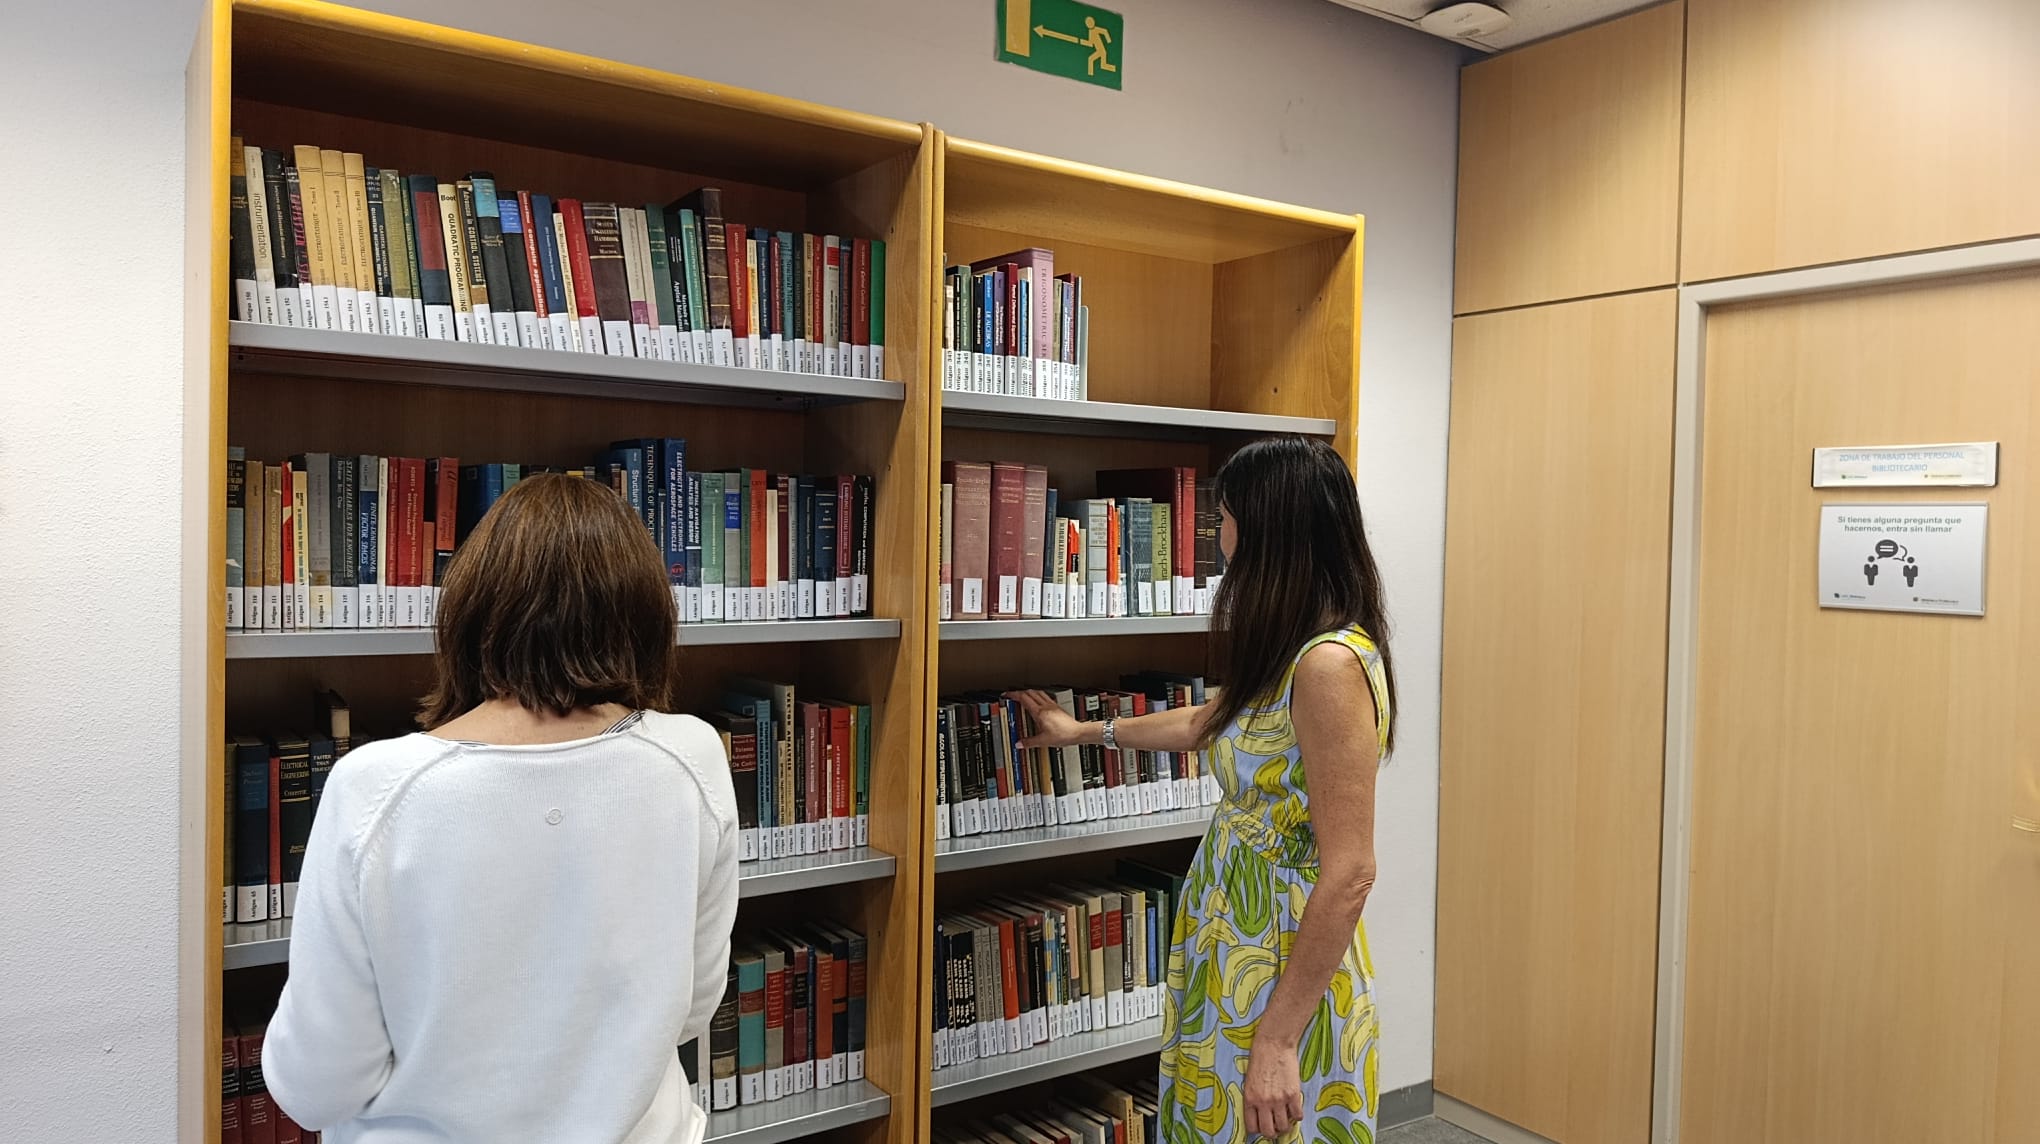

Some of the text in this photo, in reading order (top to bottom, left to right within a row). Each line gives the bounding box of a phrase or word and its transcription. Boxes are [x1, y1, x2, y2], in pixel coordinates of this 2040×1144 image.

[254, 193, 268, 258] instrumentation
[448, 214, 460, 256] QUADRATIC
[468, 227, 476, 254] CONTROL
[528, 229, 545, 318] computer applications
[1872, 453, 1905, 461] TRABAJO
[1924, 451, 1964, 460] PERSONAL
[1872, 464, 1928, 472] BIBLIOTECARIO
[648, 496, 654, 506] OF
[1874, 517, 1902, 525] alguna
[1904, 517, 1942, 525] pregunta
[281, 771, 310, 780] ENGINEERING
